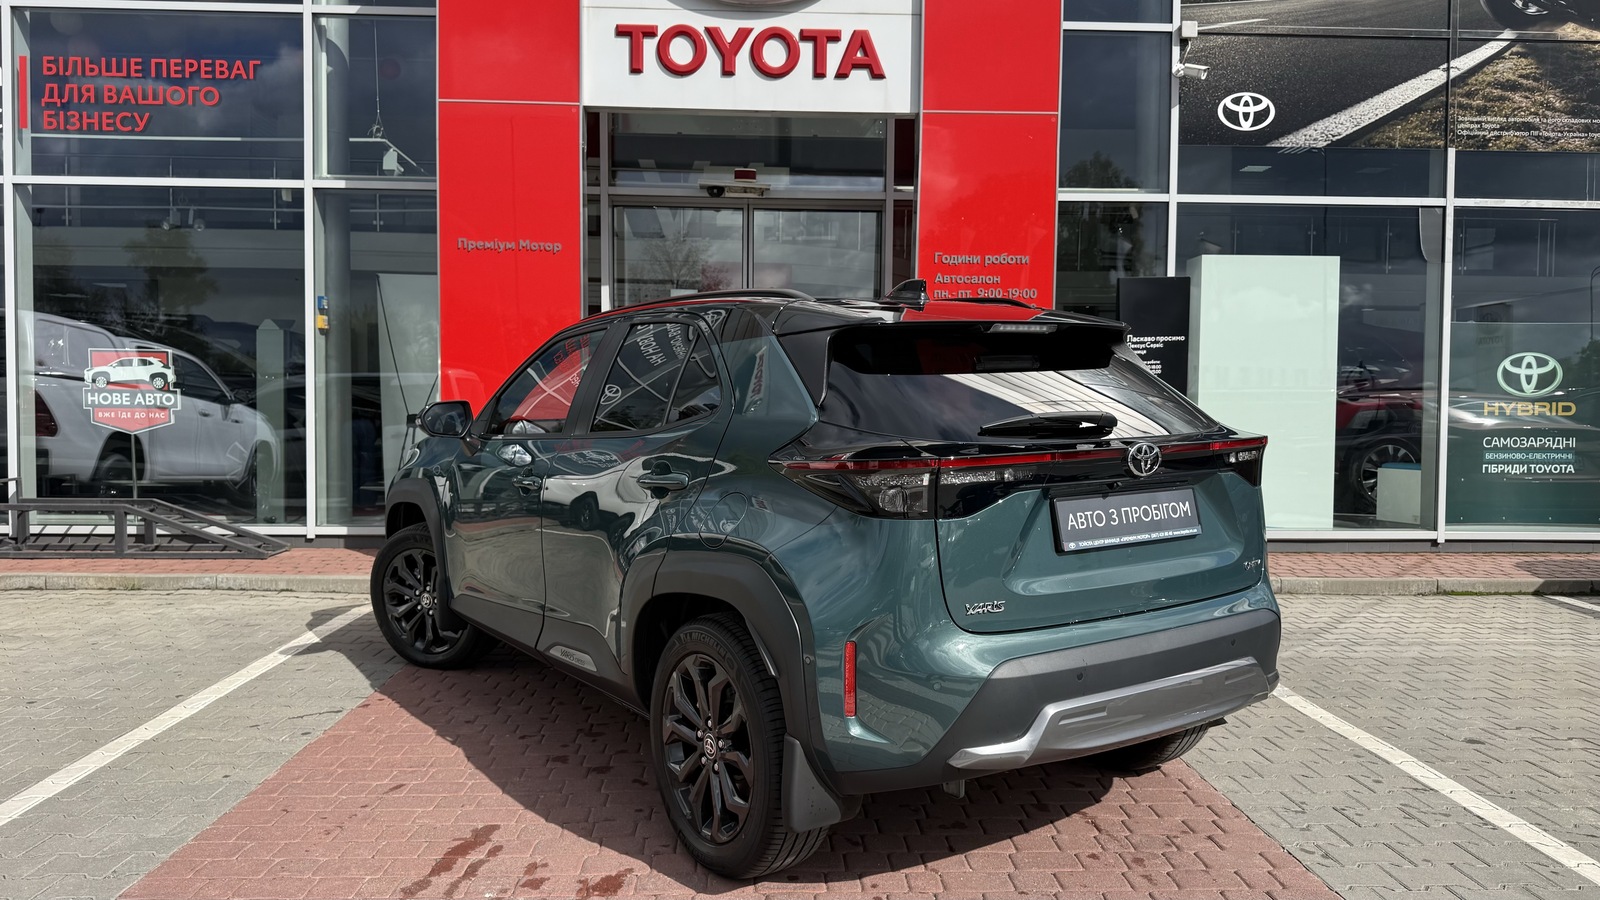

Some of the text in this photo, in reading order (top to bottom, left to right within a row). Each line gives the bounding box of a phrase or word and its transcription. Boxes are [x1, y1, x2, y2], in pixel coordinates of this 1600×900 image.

[615, 24, 887, 80] TOYOTA
[42, 55, 262, 80] БІЛЬШЕ ПЕРЕВАГ
[41, 83, 221, 106] ДЛЯ ВАШОГО
[42, 110, 151, 132] БІЗНЕСУ
[457, 237, 562, 253] Преміум Мотор
[934, 252, 1029, 266] Години роботи
[934, 273, 1001, 284] Автосалон
[1126, 334, 1185, 343] Ласкаво просимо
[87, 392, 175, 406] НОВЕ АВТО
[118, 411, 132, 419] ЇДЕ
[134, 411, 146, 419] ДО
[149, 411, 166, 419] НАС
[1483, 401, 1577, 416] HYBRID
[1483, 436, 1576, 449] САМОЗАРЯДНІ
[1485, 452, 1573, 460] БЕНЗИНОВО-ЕЛЕКТРИЧНІ
[1482, 464, 1575, 475] ГІБРИДИ TOYOTA
[1067, 501, 1192, 531] АВТО З ПРОБІГОМ
[965, 600, 1006, 616] YARIS
[691, 632, 728, 661] MICHELIN
